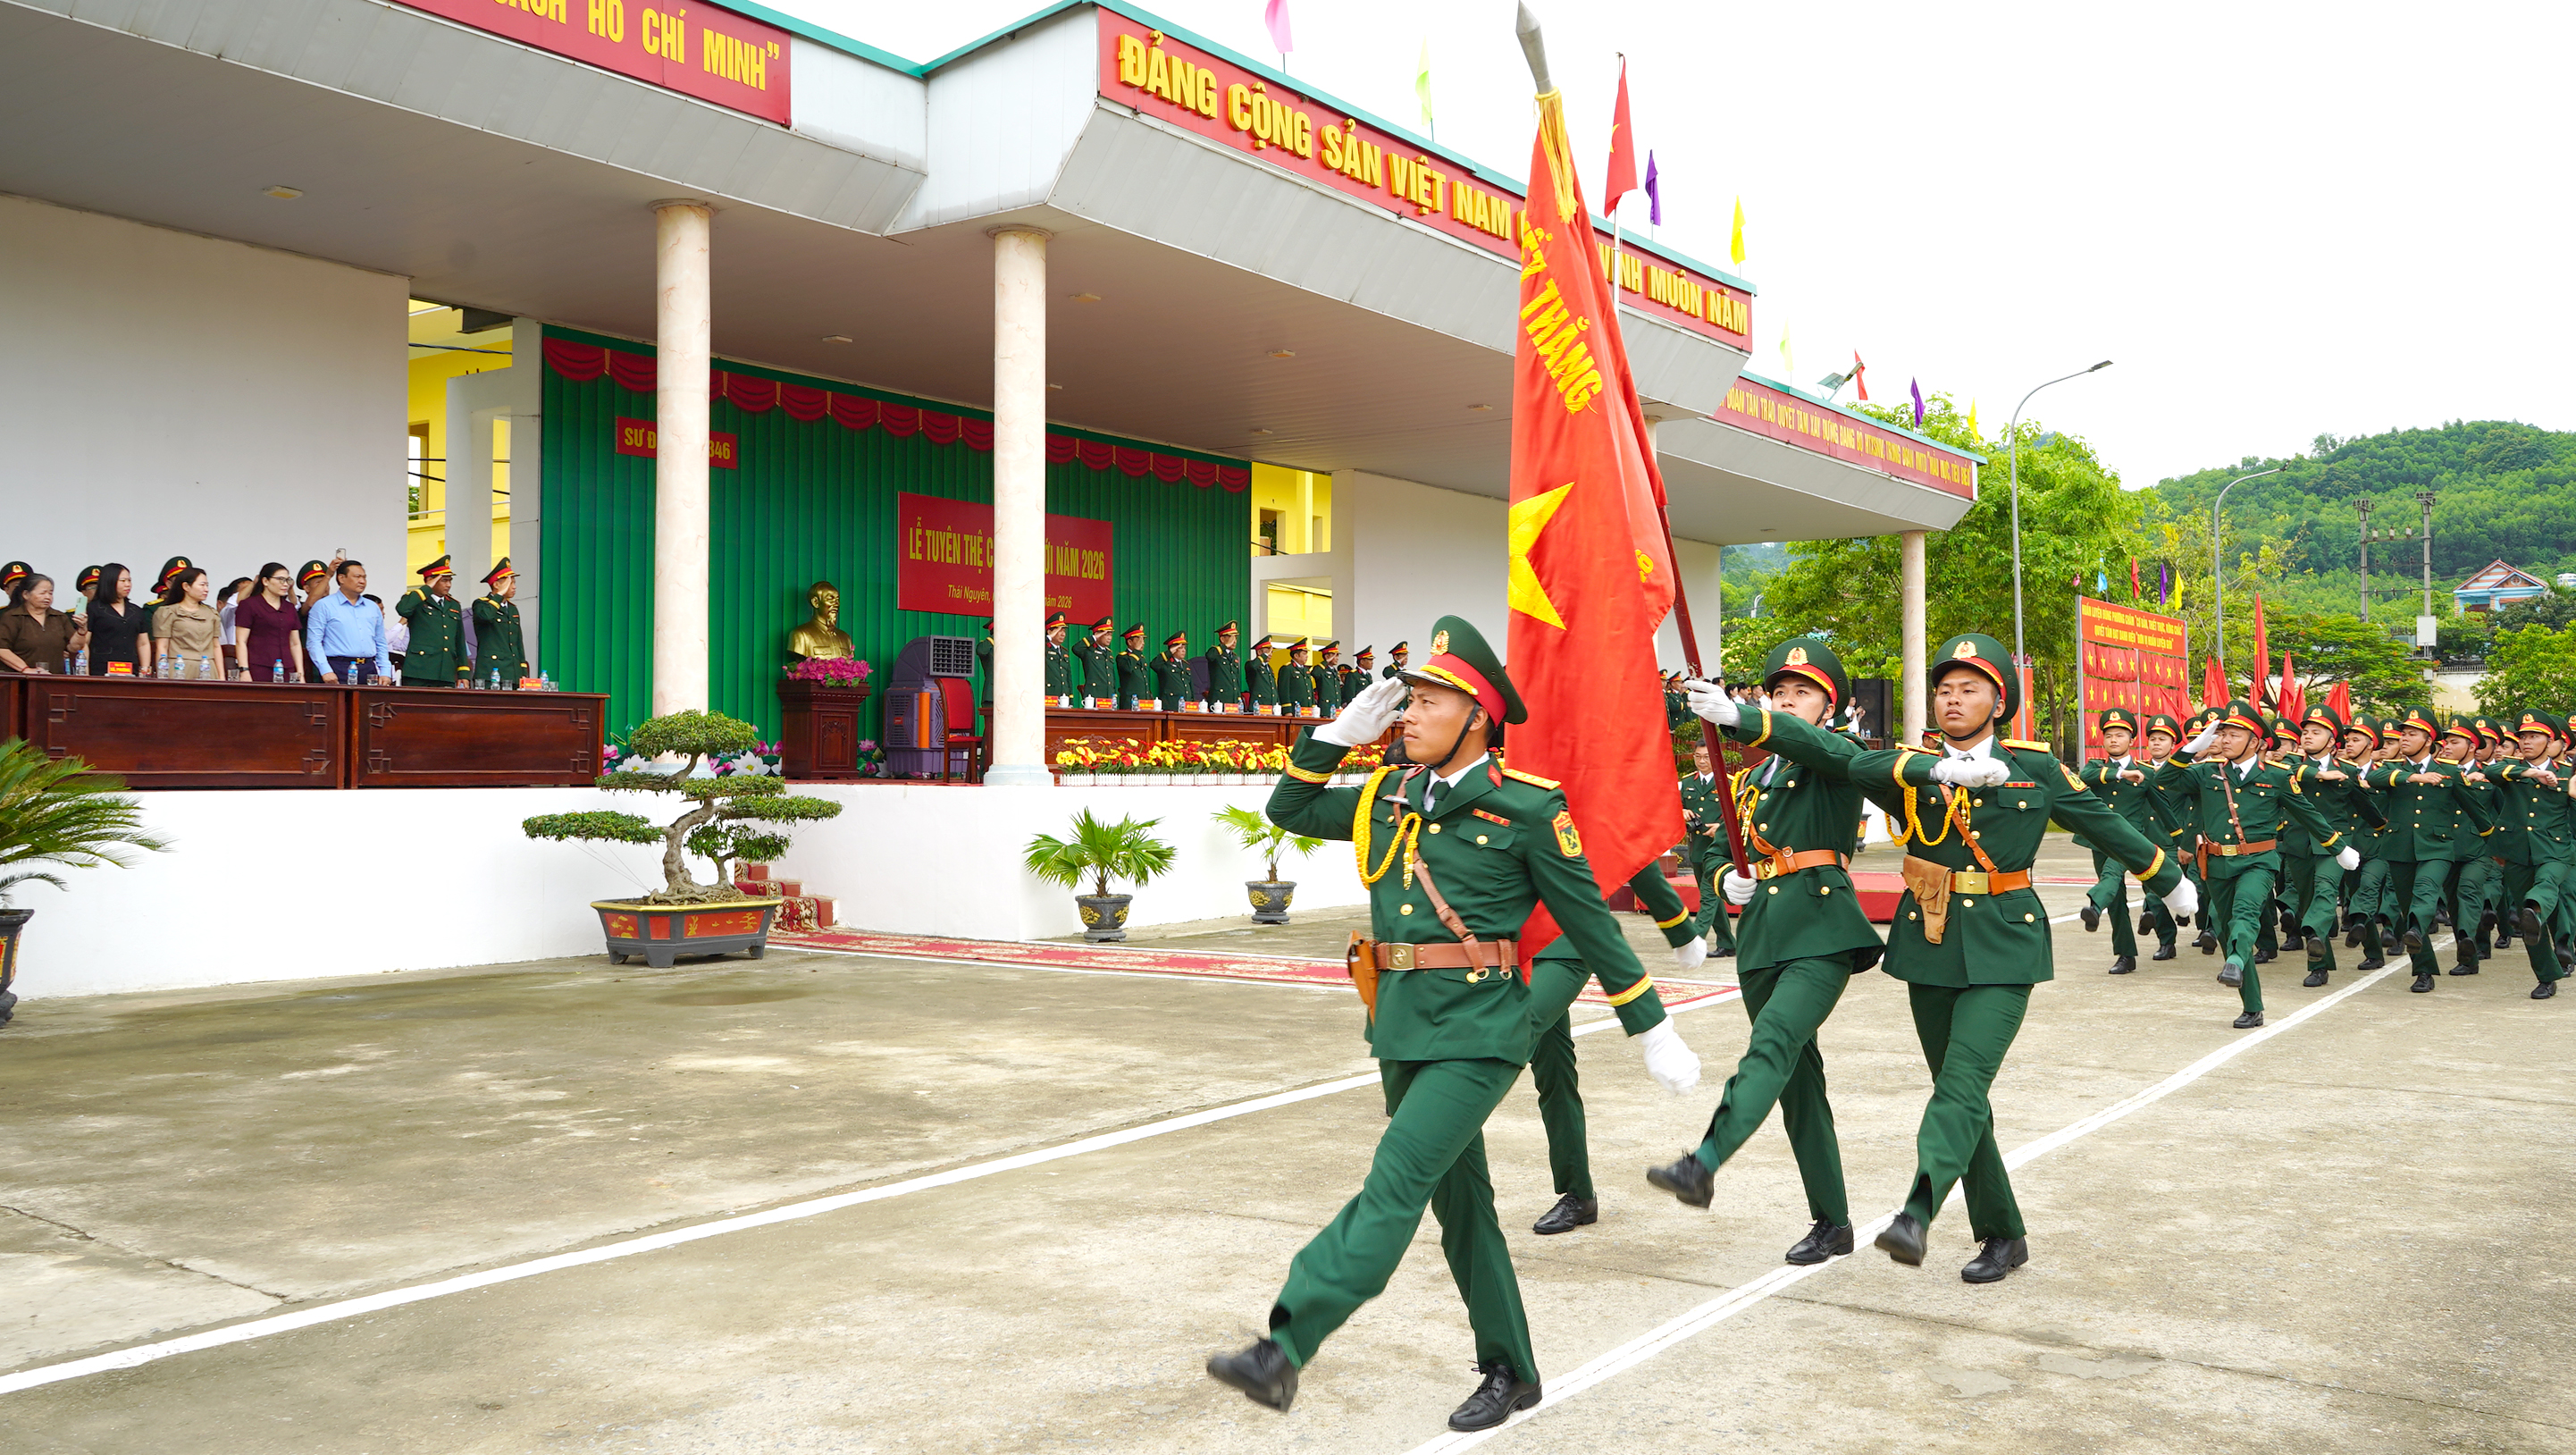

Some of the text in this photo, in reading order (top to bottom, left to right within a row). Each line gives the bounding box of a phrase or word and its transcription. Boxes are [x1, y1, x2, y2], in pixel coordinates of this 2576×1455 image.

[642, 10, 685, 64] CHÍ
[1118, 29, 1218, 120] ĐẢNG
[1228, 81, 1313, 159] CỘNG
[1321, 118, 1382, 189] SẢN
[1387, 156, 1447, 215] VIỆT
[1452, 180, 1512, 240] NAM
[1598, 241, 1643, 294] VNH
[1647, 265, 1703, 318] MUÔN
[1706, 287, 1749, 336] NĂM
[1520, 278, 1603, 416] THẮNG
[624, 427, 645, 448] SƯ
[1777, 400, 1795, 430] QUYẾT
[909, 516, 922, 560] LỄ
[925, 525, 961, 565] TUYÊN
[963, 529, 984, 575] THỆ
[1056, 540, 1079, 577] NĂM
[1081, 549, 1105, 581] 2026
[948, 584, 963, 599] Thái
[963, 585, 991, 604] Nguyên,
[1057, 595, 1072, 609] 2026
